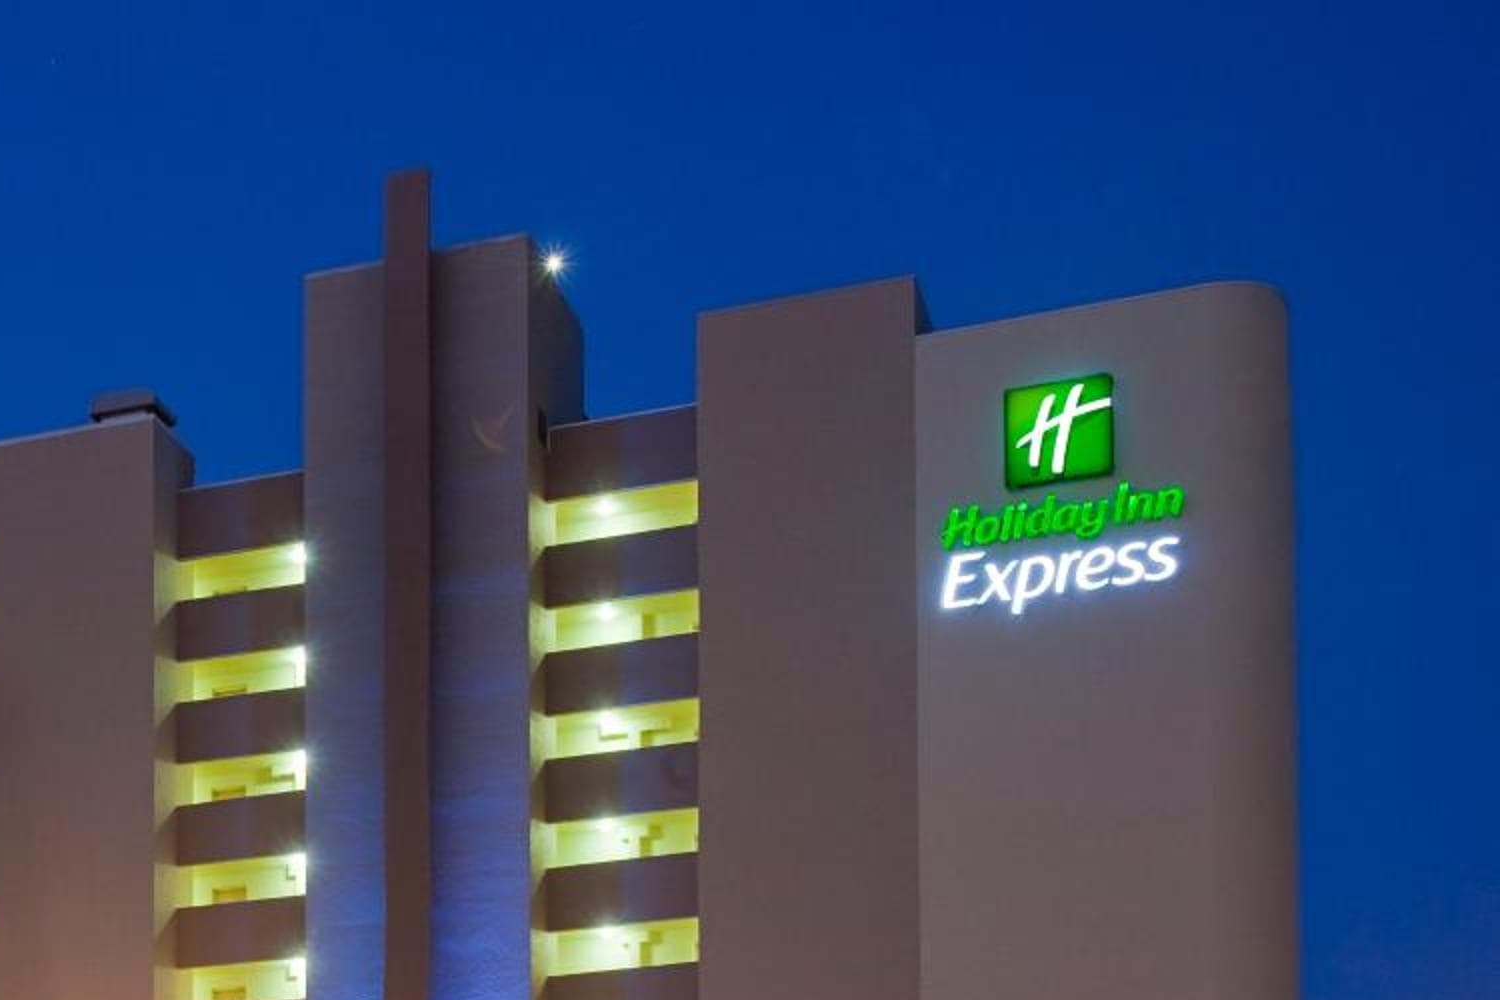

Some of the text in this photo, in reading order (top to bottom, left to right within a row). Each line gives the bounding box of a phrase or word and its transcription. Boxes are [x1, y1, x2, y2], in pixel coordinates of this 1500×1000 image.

[1016, 383, 1111, 473] H
[941, 481, 1185, 549] Holiday Inn
[940, 537, 1181, 615] Express
